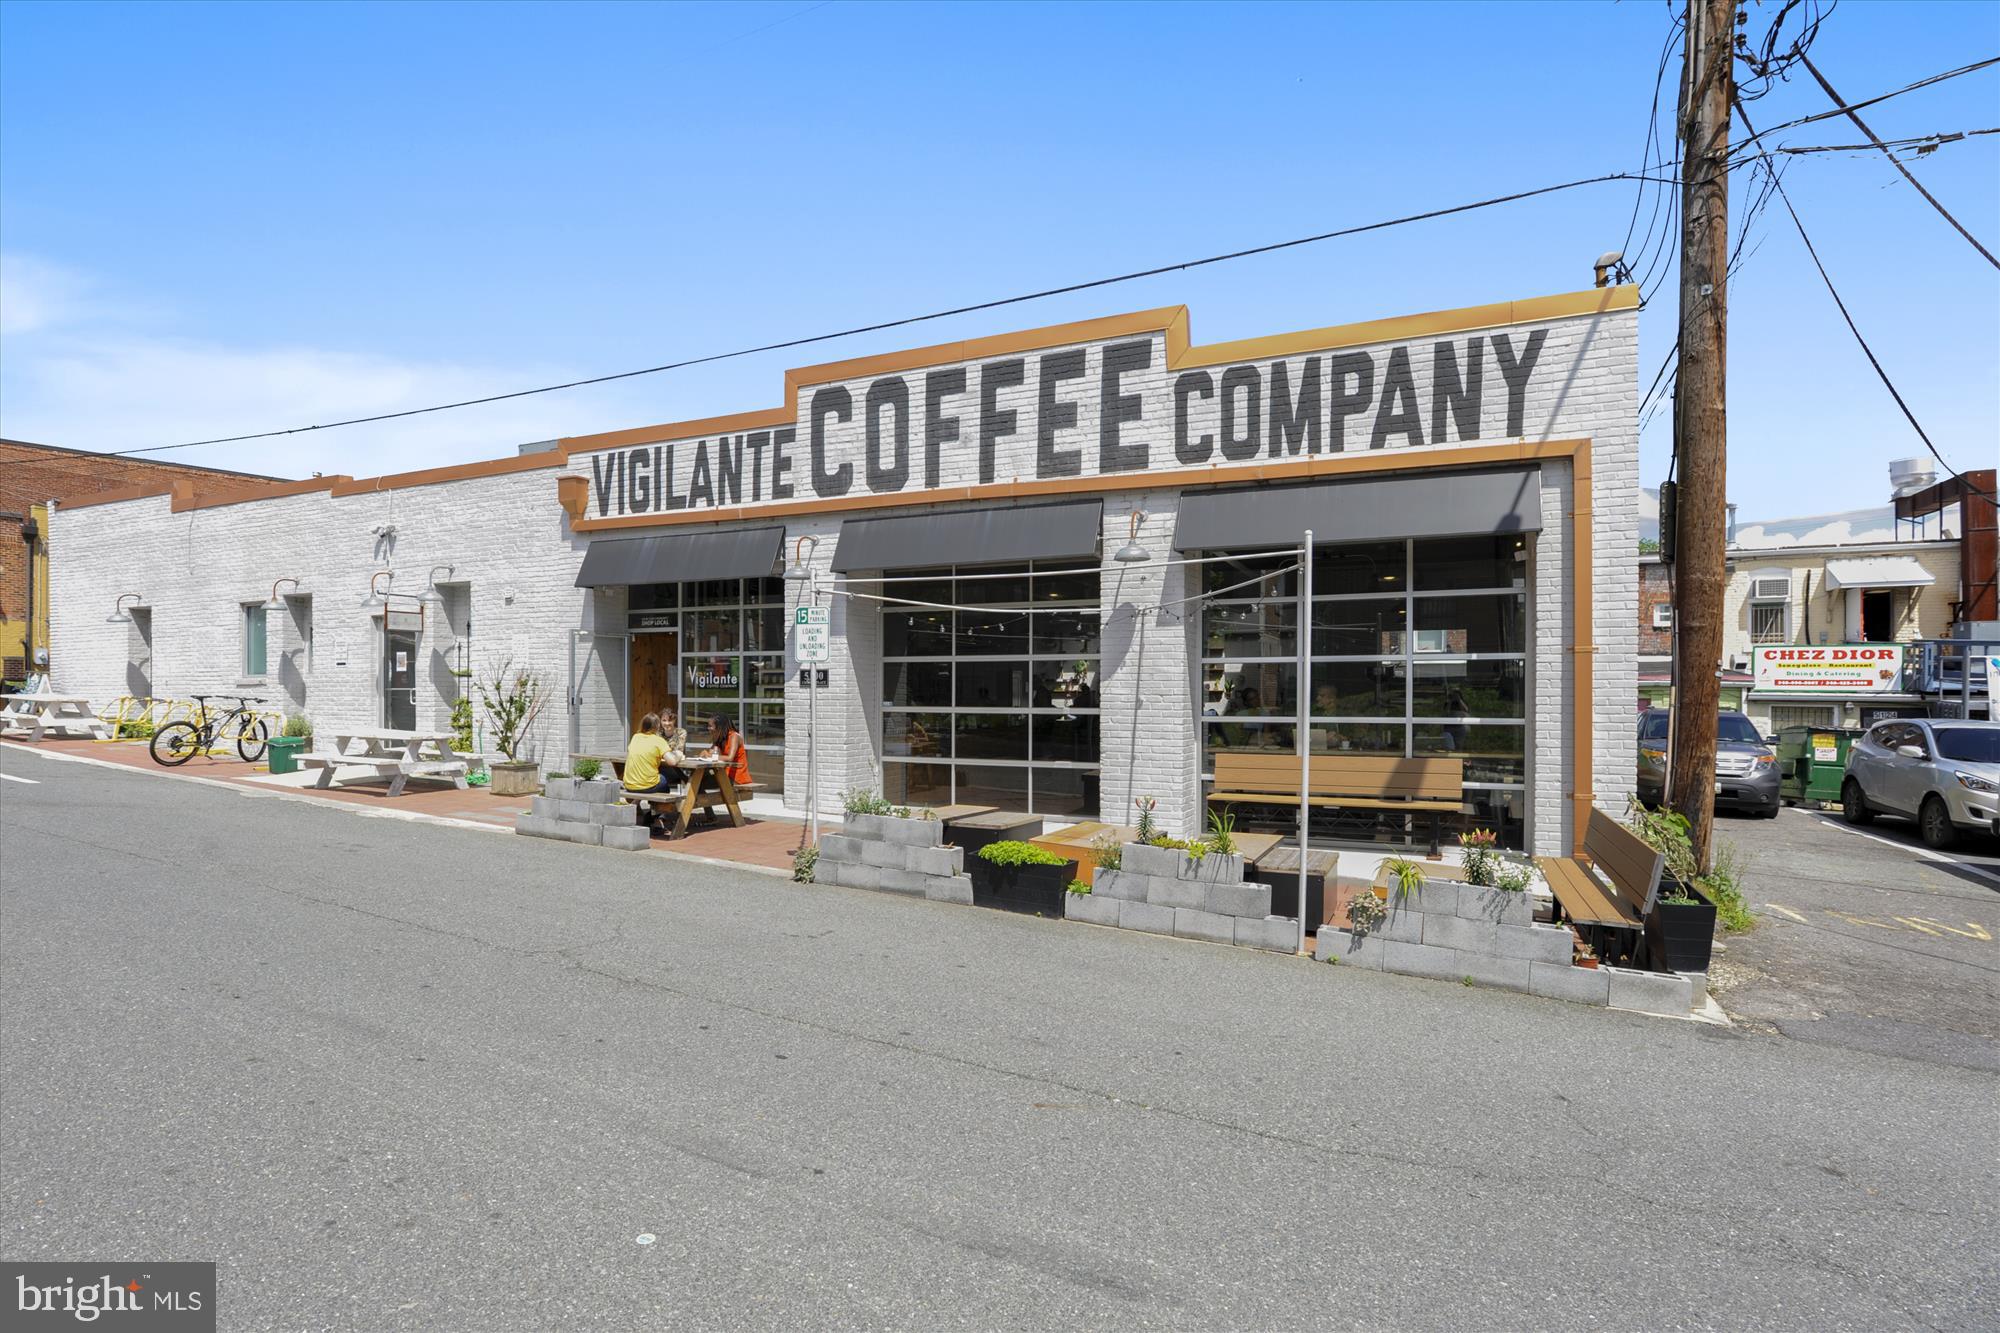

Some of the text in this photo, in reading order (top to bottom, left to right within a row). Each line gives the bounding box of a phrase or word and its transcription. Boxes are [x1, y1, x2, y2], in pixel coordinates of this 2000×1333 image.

[592, 329, 1549, 517] VIGILANTE COFFEE COMPANY
[797, 610, 808, 623] 15
[1764, 650, 1894, 660] CHEZ DIOR
[688, 665, 738, 687] Vigilante
